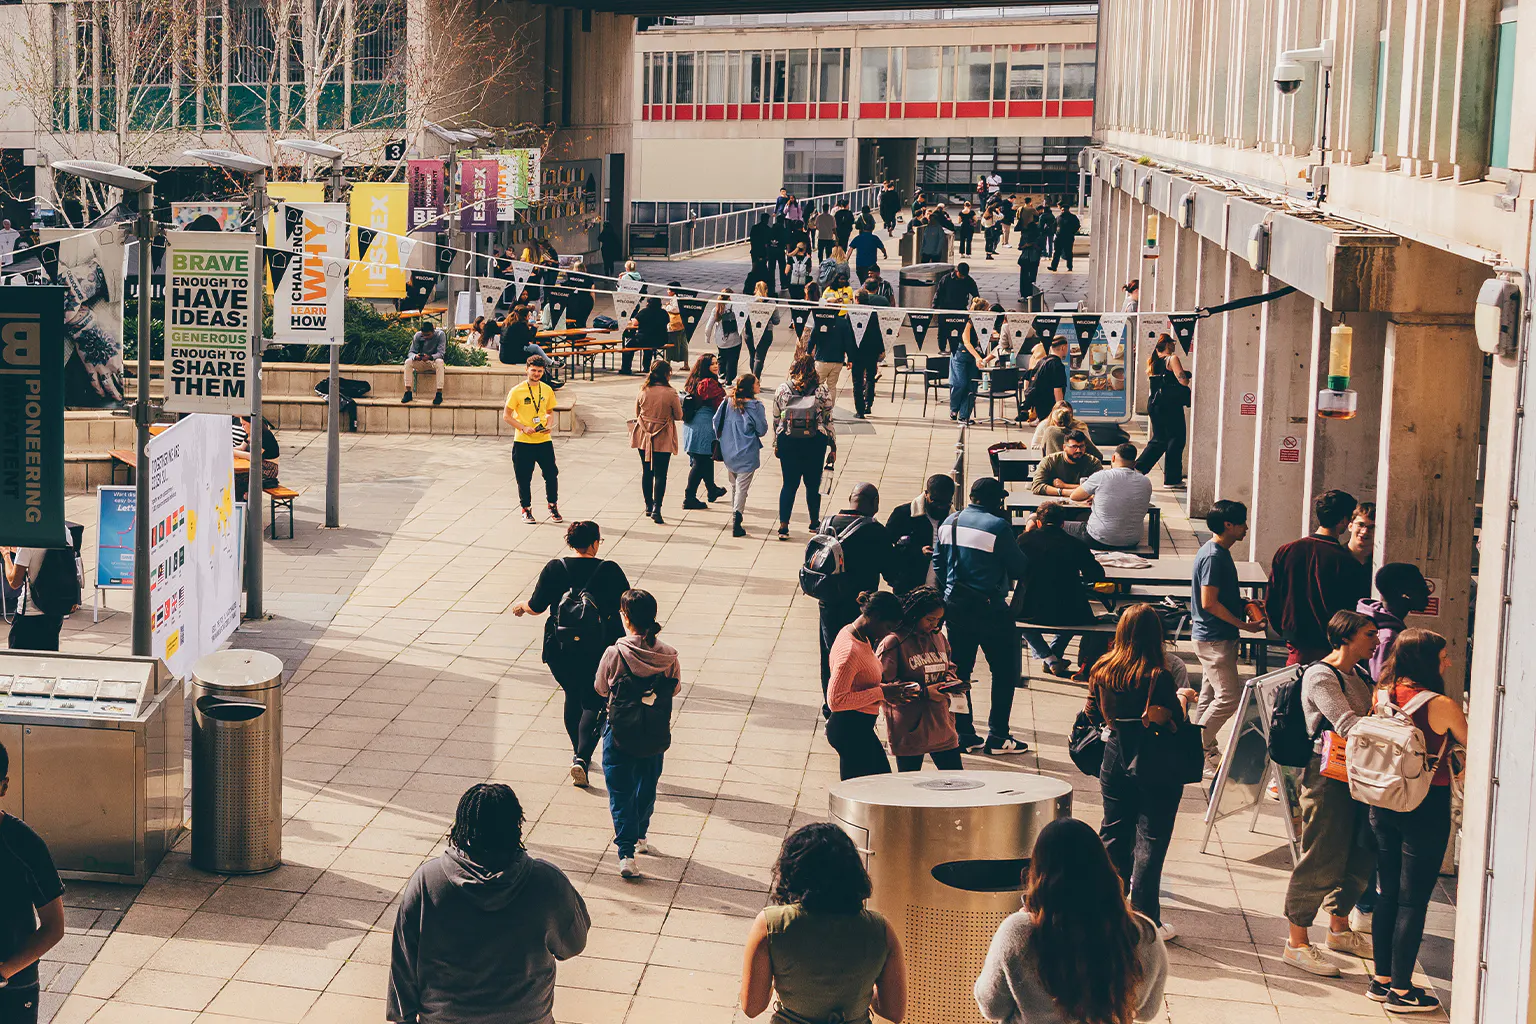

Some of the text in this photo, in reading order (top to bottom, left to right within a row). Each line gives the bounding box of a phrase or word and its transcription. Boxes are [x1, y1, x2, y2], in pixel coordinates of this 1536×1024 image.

[391, 146, 400, 158] 3
[474, 167, 486, 222] ESSEX
[414, 210, 437, 222] BE
[370, 194, 388, 280] ESSEX
[172, 254, 248, 272] BRAVE
[304, 218, 327, 302] WHY
[172, 277, 248, 288] ENOUGH TO
[172, 288, 248, 310] HAVE
[171, 309, 248, 328] IDEAS:
[290, 306, 326, 314] LEARN
[290, 316, 326, 326] HOW
[171, 332, 246, 344] GENEROUS
[170, 348, 246, 360] ENOUGH TO
[171, 360, 246, 377] SHARE
[170, 377, 246, 398] THEM
[25, 379, 42, 523] PIONEERING
[116, 504, 136, 512] Let's
